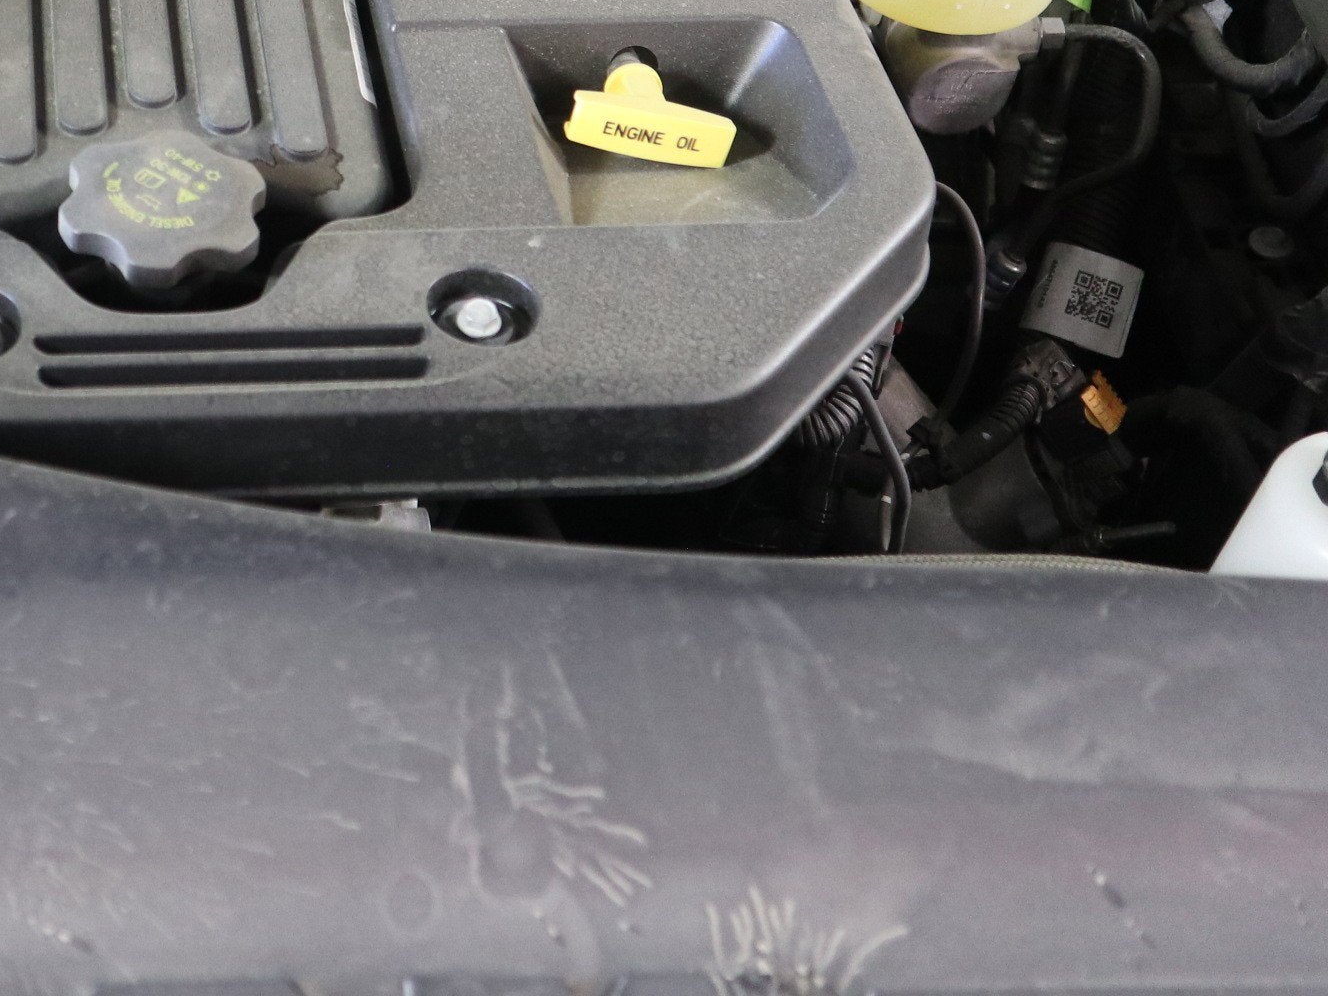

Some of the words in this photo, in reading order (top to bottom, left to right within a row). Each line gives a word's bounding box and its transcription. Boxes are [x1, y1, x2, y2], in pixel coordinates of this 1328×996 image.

[603, 121, 666, 146] ENGINE
[676, 136, 701, 152] OIL
[148, 215, 194, 229] DIESEL
